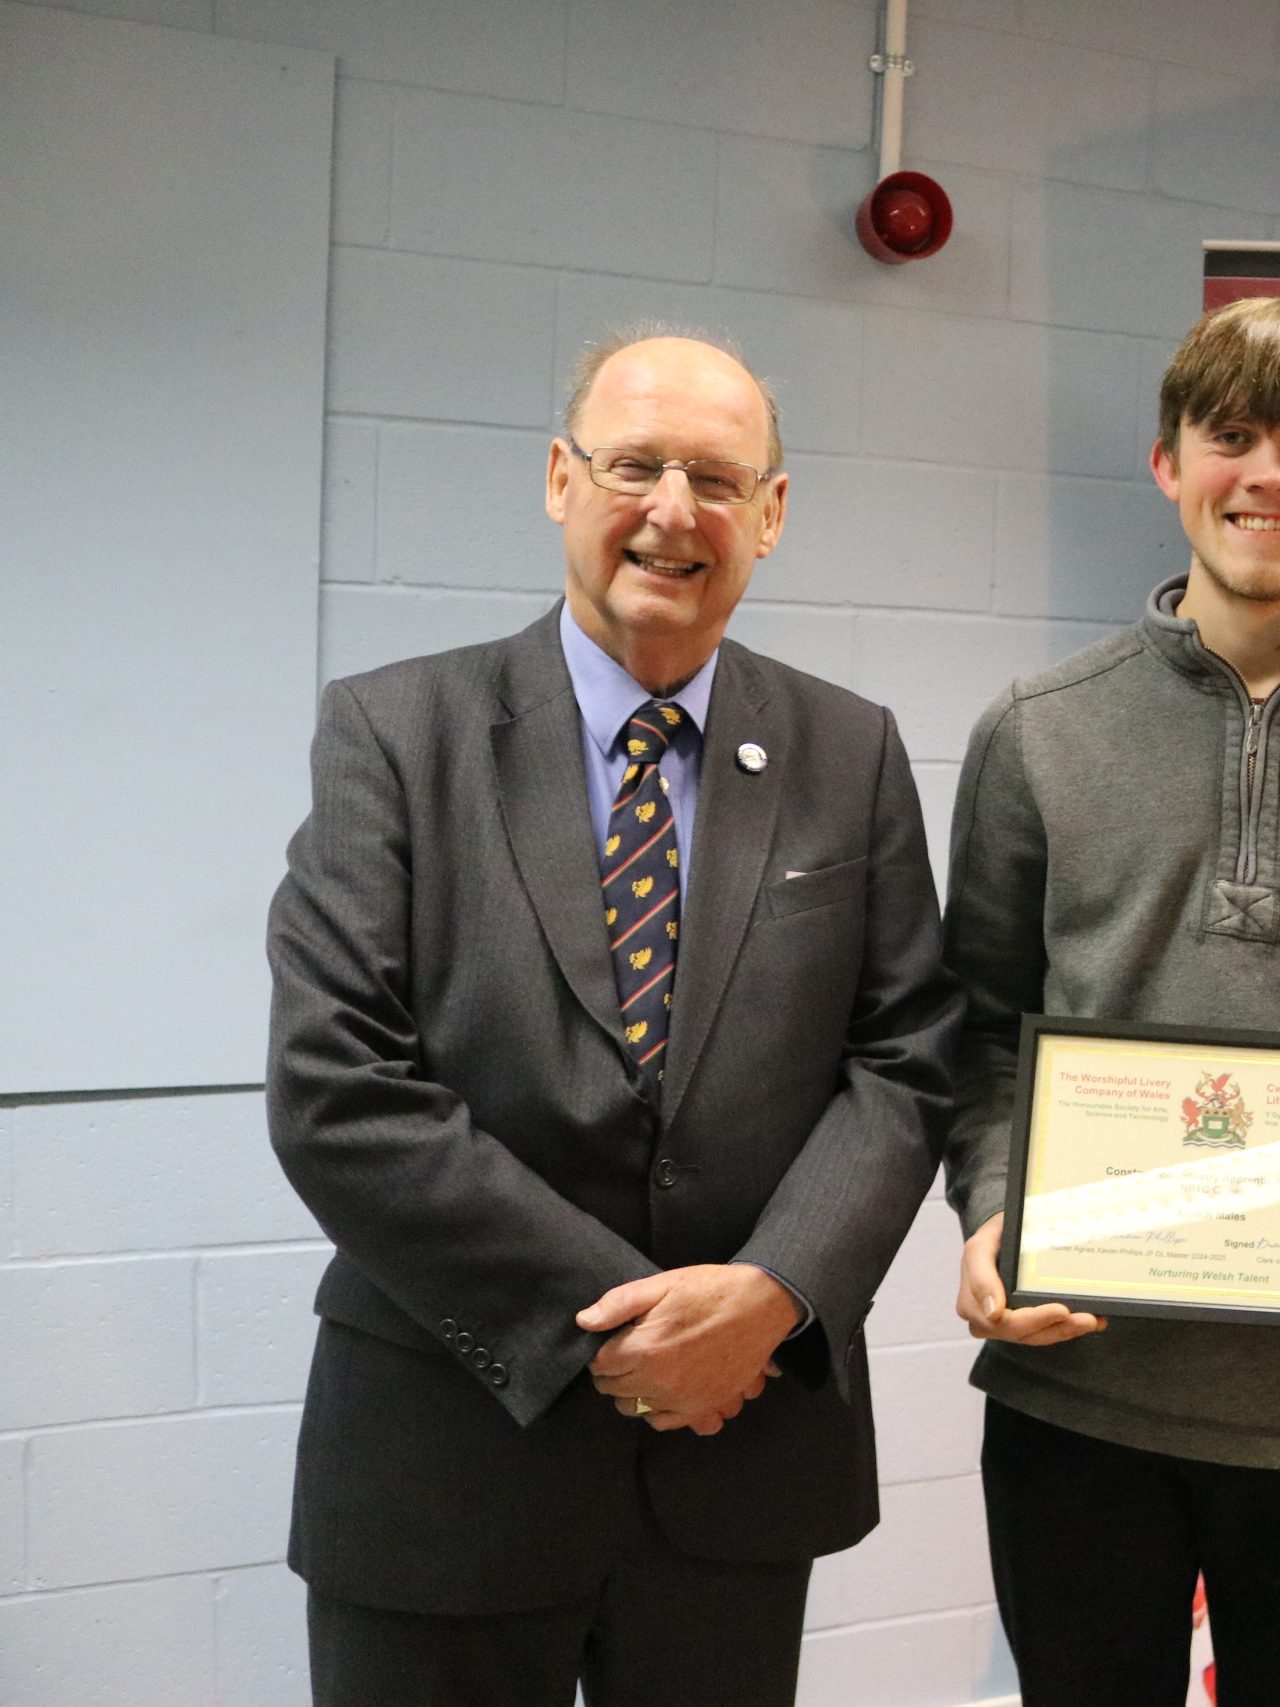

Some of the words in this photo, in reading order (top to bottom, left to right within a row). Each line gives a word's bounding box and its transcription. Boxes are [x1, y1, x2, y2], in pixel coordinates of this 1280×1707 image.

[1059, 1072, 1078, 1081] The
[1081, 1073, 1137, 1086] Worshipful
[1140, 1077, 1172, 1089] Livery
[1075, 1085, 1124, 1099] Company
[1126, 1089, 1137, 1097] of
[1140, 1090, 1170, 1100] Wales
[1224, 1239, 1255, 1249] Signed
[1149, 1267, 1199, 1281] Nurturing
[1202, 1270, 1234, 1281] Welsh
[1237, 1272, 1270, 1284] Talent
